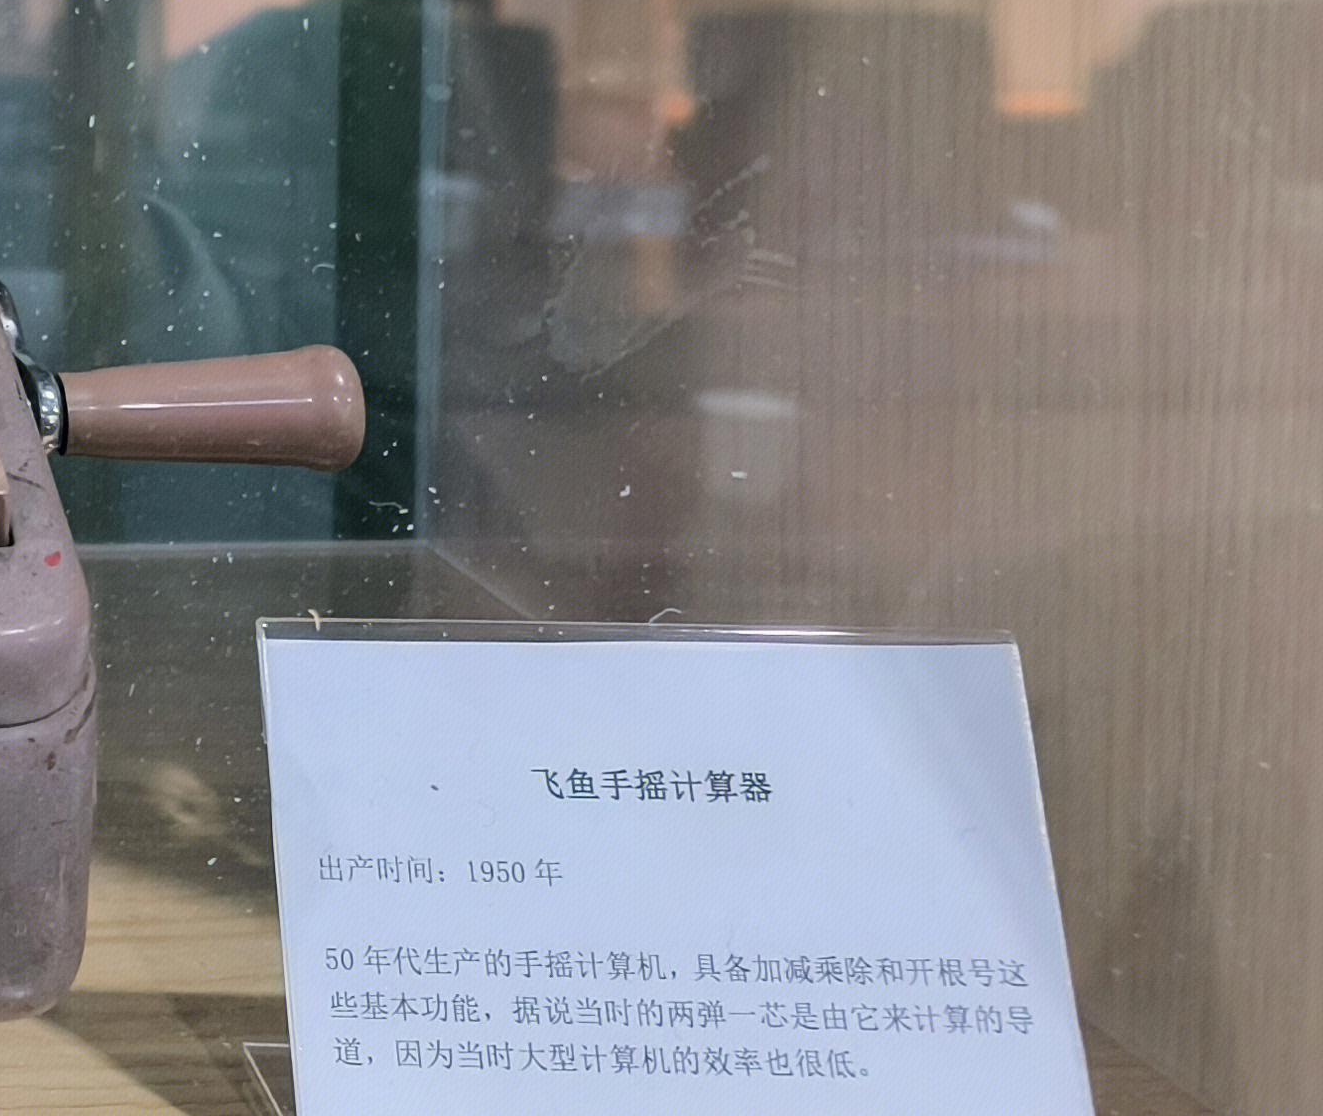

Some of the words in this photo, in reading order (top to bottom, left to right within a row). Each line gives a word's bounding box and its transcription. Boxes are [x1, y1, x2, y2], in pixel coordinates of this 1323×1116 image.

[529, 768, 774, 803] 飞鱼手摇计算器
[330, 990, 1035, 1036] 些基本功能，据说当时的两弹一芯是由它来计算的导
[332, 1036, 871, 1081] 道，因为当时大型计算机的效率也很低。
